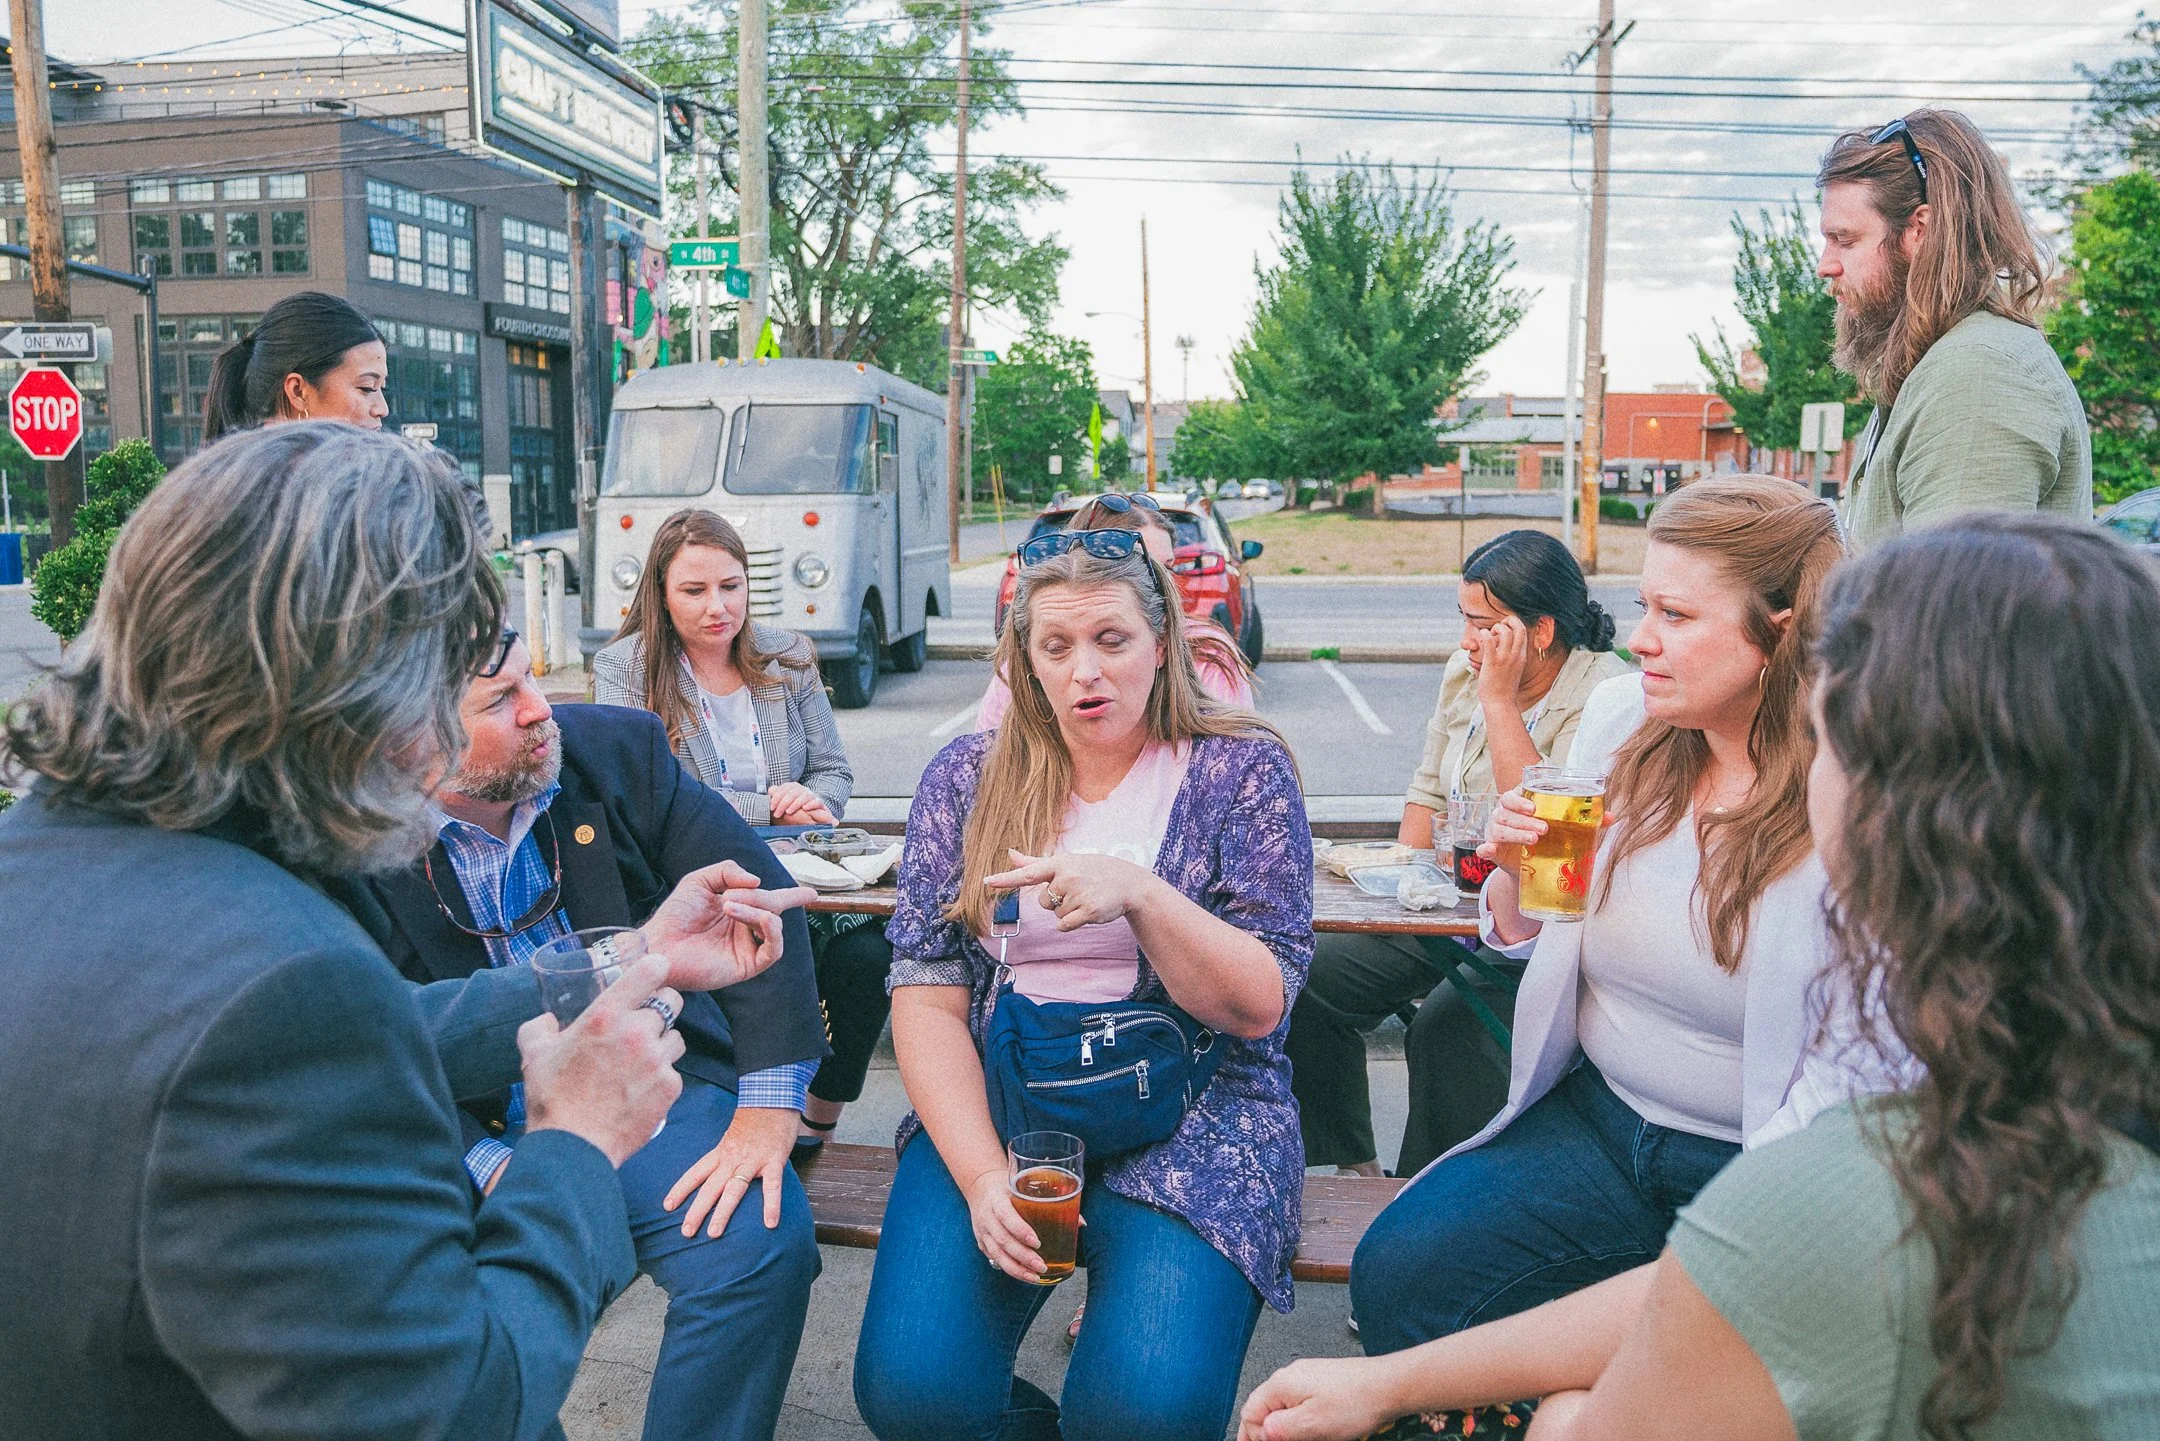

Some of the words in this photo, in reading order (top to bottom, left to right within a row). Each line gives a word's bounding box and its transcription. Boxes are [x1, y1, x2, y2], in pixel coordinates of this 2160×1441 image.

[692, 246, 716, 262] 4th
[24, 336, 50, 349] ONE
[55, 336, 84, 348] WAY
[15, 396, 77, 431] STOP
